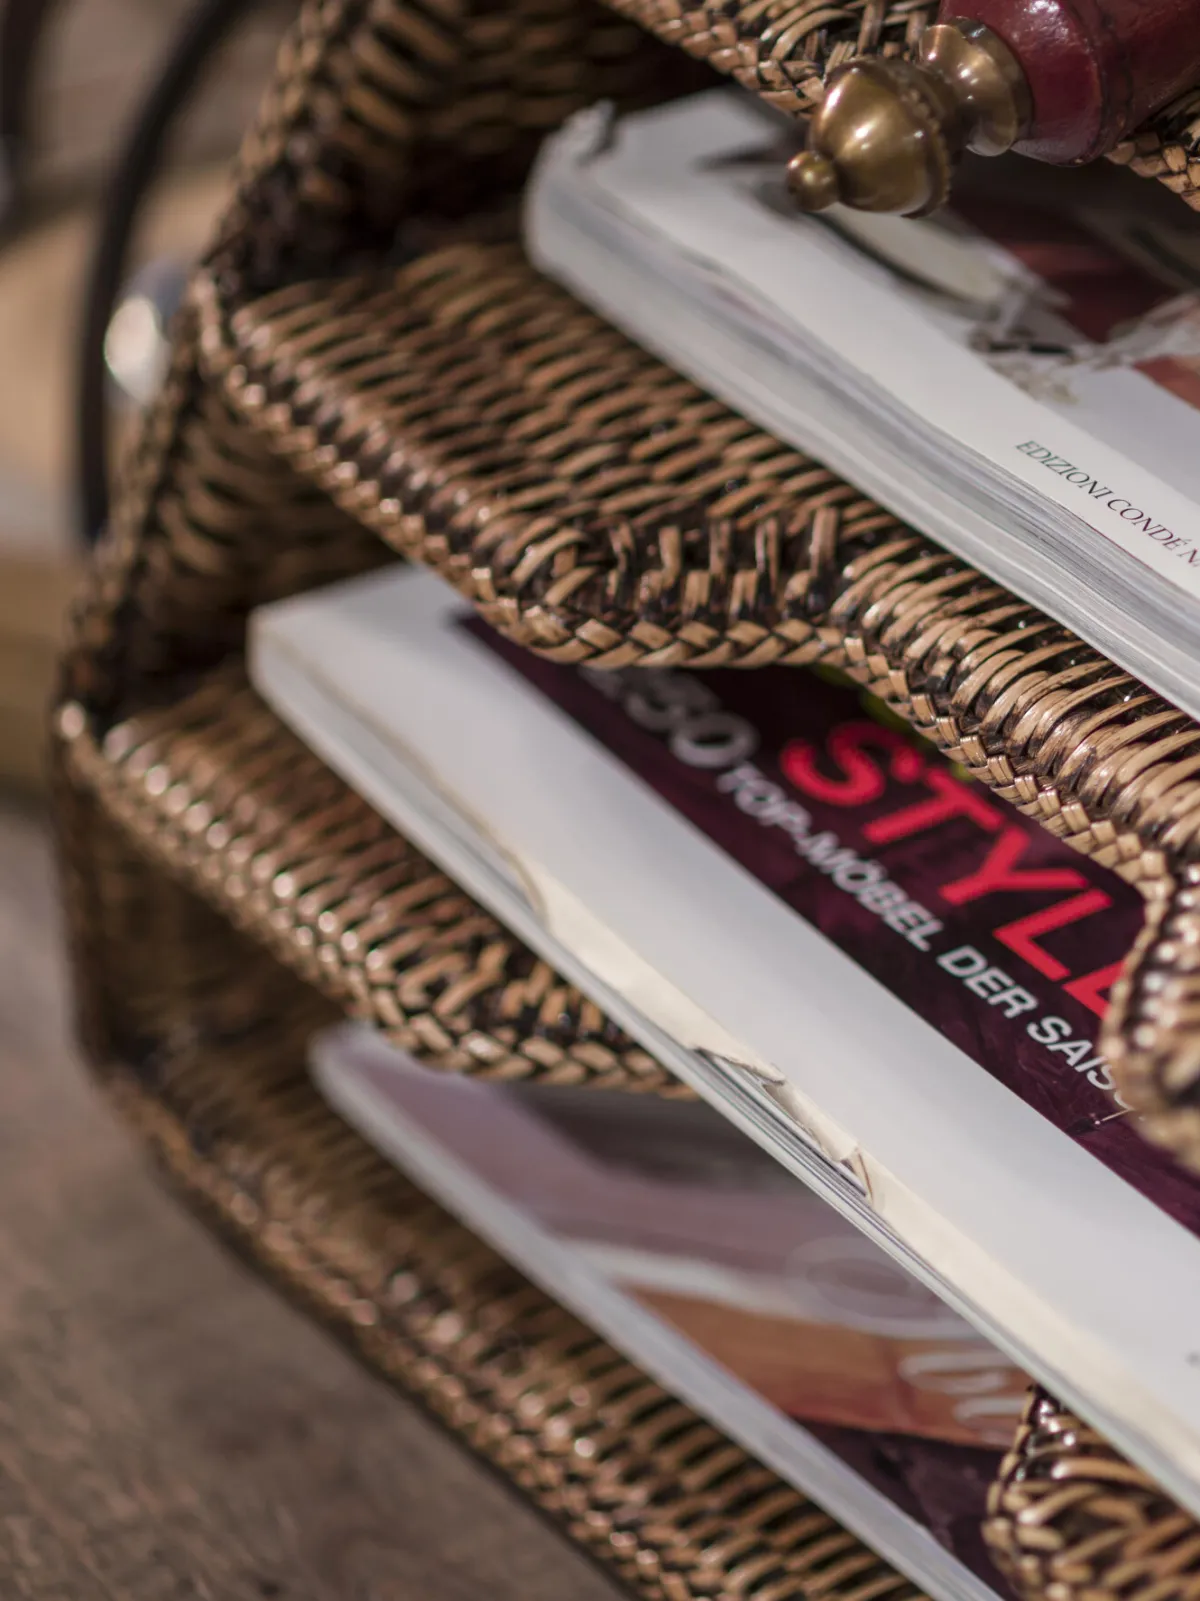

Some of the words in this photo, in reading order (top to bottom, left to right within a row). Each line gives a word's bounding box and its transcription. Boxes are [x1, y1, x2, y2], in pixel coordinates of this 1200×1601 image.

[1015, 441, 1113, 500] EDIZIONI
[1107, 498, 1190, 551] CONDÉ
[936, 945, 1038, 1019] DER
[1026, 1016, 1133, 1111] SAIS
